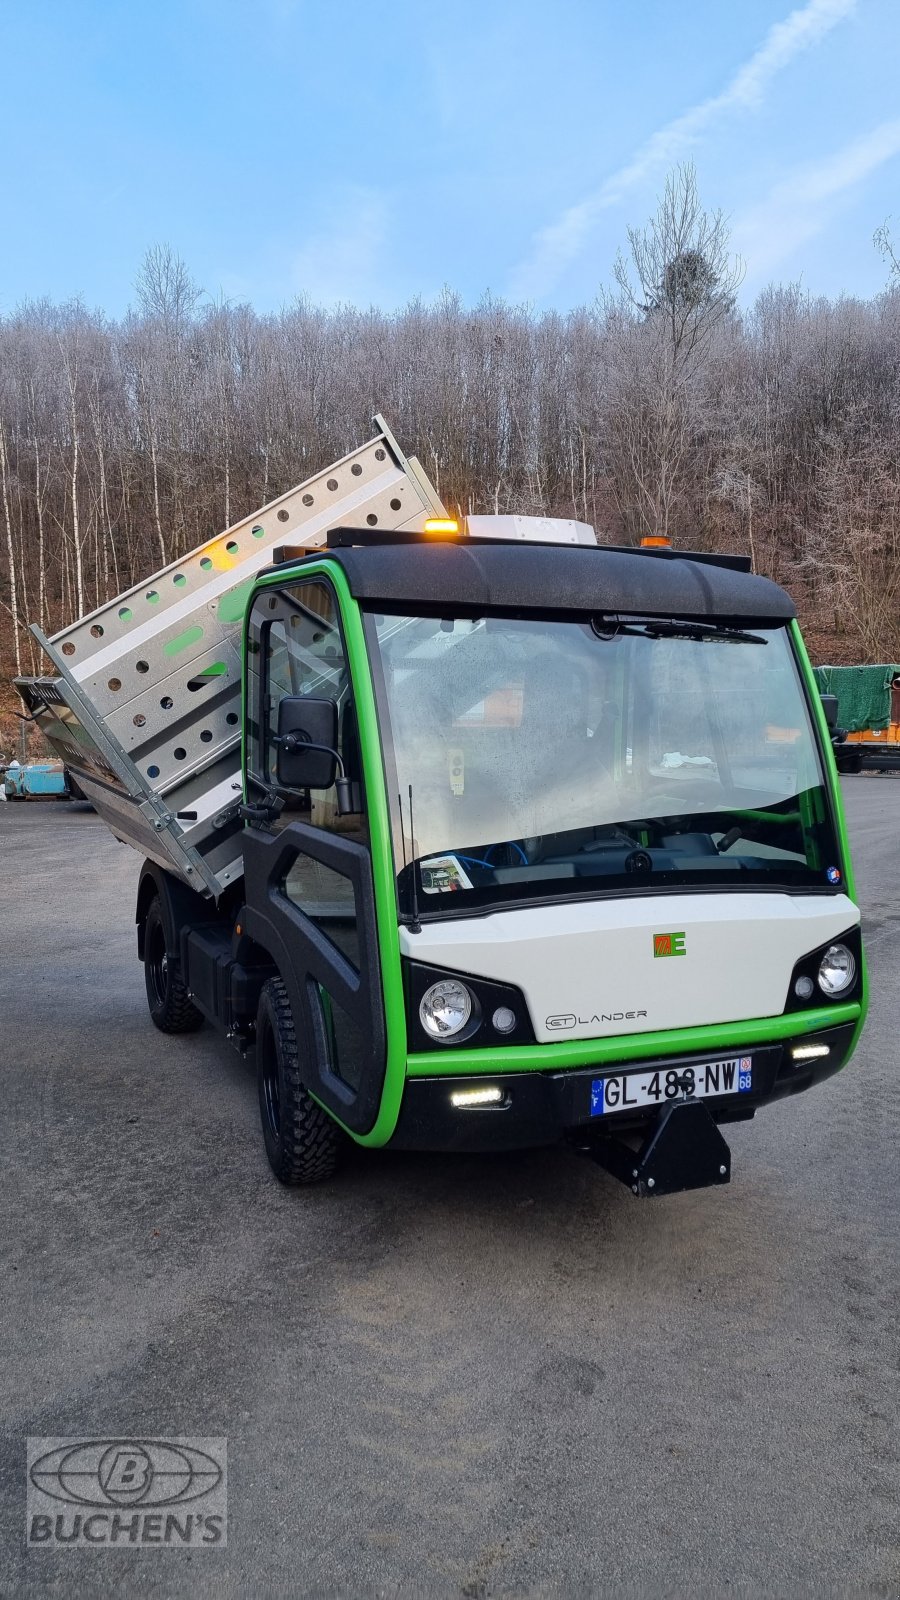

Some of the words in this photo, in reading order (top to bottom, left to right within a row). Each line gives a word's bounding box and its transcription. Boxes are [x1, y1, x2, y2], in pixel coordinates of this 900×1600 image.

[578, 1010, 648, 1025] LANDER
[739, 1075, 752, 1090] 68
[592, 1097, 599, 1108] F
